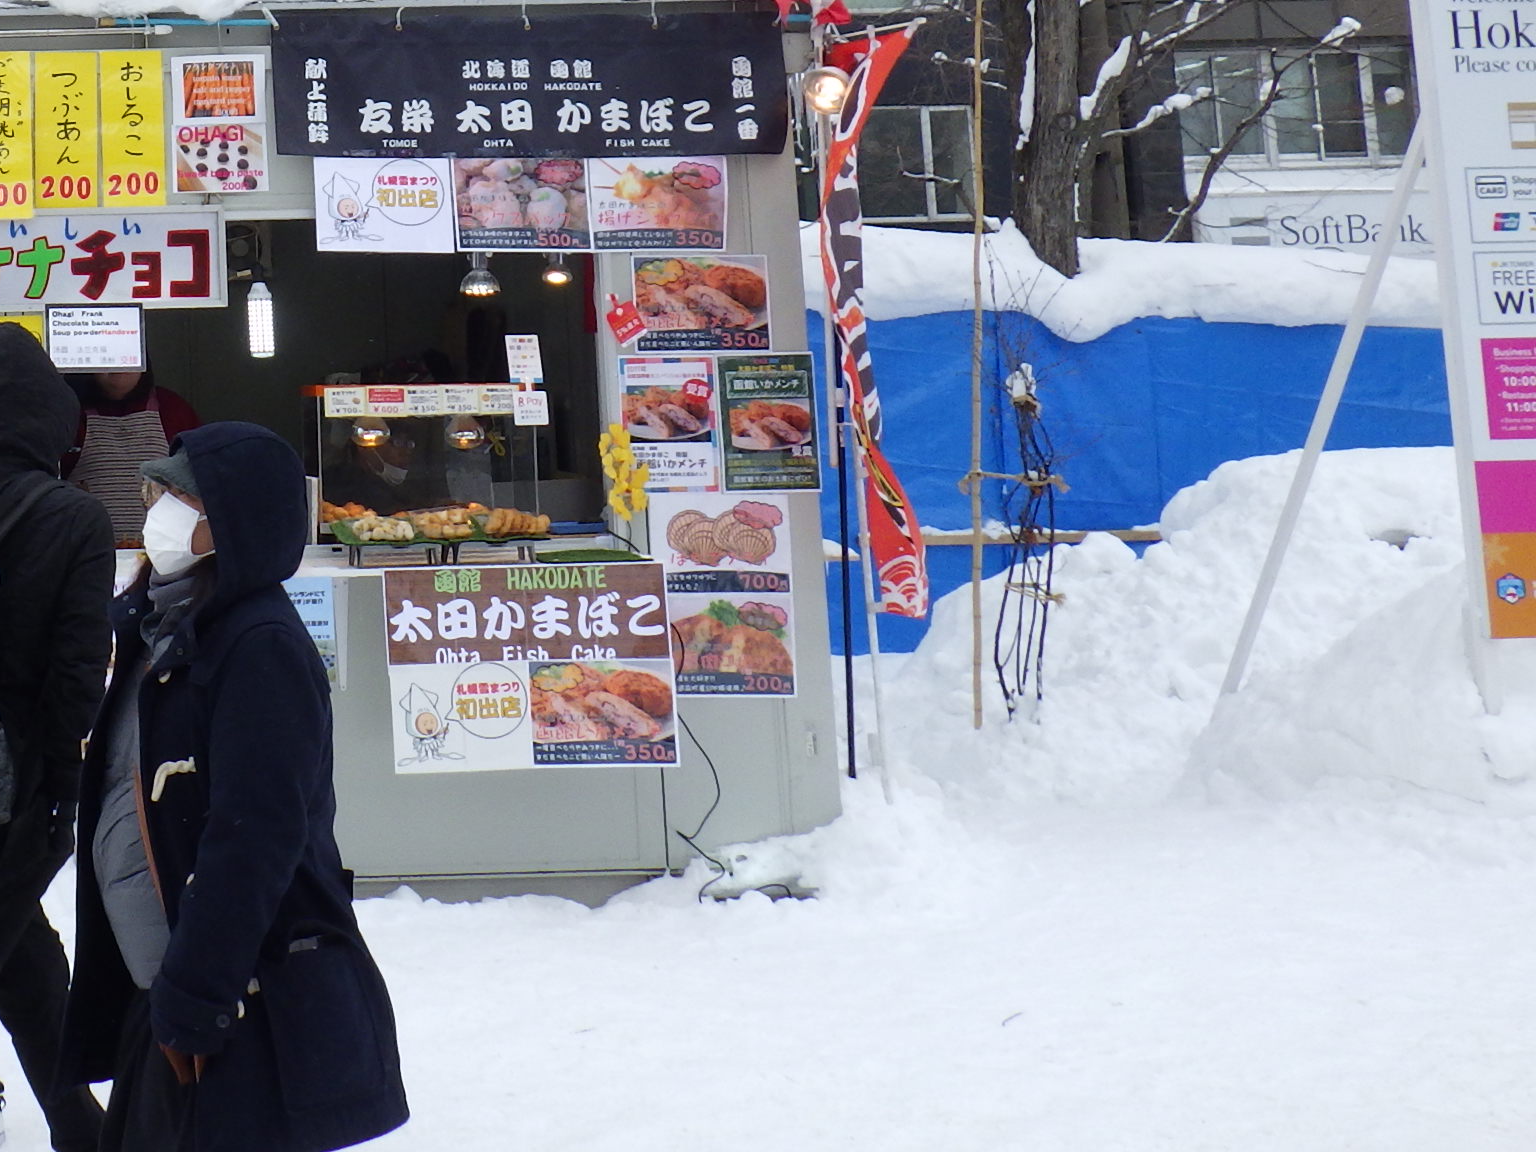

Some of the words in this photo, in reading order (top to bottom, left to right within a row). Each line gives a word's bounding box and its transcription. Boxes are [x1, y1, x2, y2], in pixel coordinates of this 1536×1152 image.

[1447, 9, 1536, 49] Hok
[462, 58, 531, 79] 北海道
[550, 58, 592, 79] 函館
[1455, 55, 1510, 73] Please
[469, 82, 528, 92] HOKKAIDO
[544, 82, 602, 92] HAKODATE
[732, 56, 758, 141] 函館一番
[50, 71, 81, 166] つぶあん
[119, 61, 145, 157] おしるこ
[358, 99, 435, 134] 友栄
[455, 99, 533, 134] 太田
[557, 99, 716, 134] かまぼこ
[178, 125, 244, 143] OHAGI
[382, 138, 418, 148] TOMOE
[484, 138, 514, 148] OHTA
[605, 137, 636, 148] FISH
[642, 137, 671, 148] CAKE
[40, 175, 93, 199] 200
[107, 171, 160, 196] 200
[1479, 186, 1503, 195] CARD
[1513, 189, 1532, 197] your
[376, 188, 440, 209] 初出店
[536, 233, 580, 247] 500円
[675, 231, 722, 246] 350円
[1492, 270, 1536, 286] FREE
[1494, 288, 1536, 315] Wi
[721, 332, 769, 348] 350円
[1503, 376, 1536, 387] 10:00
[434, 569, 481, 593] 函館
[506, 566, 607, 591] HAKODATE
[389, 591, 665, 643] 太田かまぼこ
[435, 647, 481, 664] Ohta
[502, 645, 549, 661] Fish
[571, 644, 617, 661] Cake
[456, 696, 522, 719] 初出店
[624, 743, 676, 761] 350円
